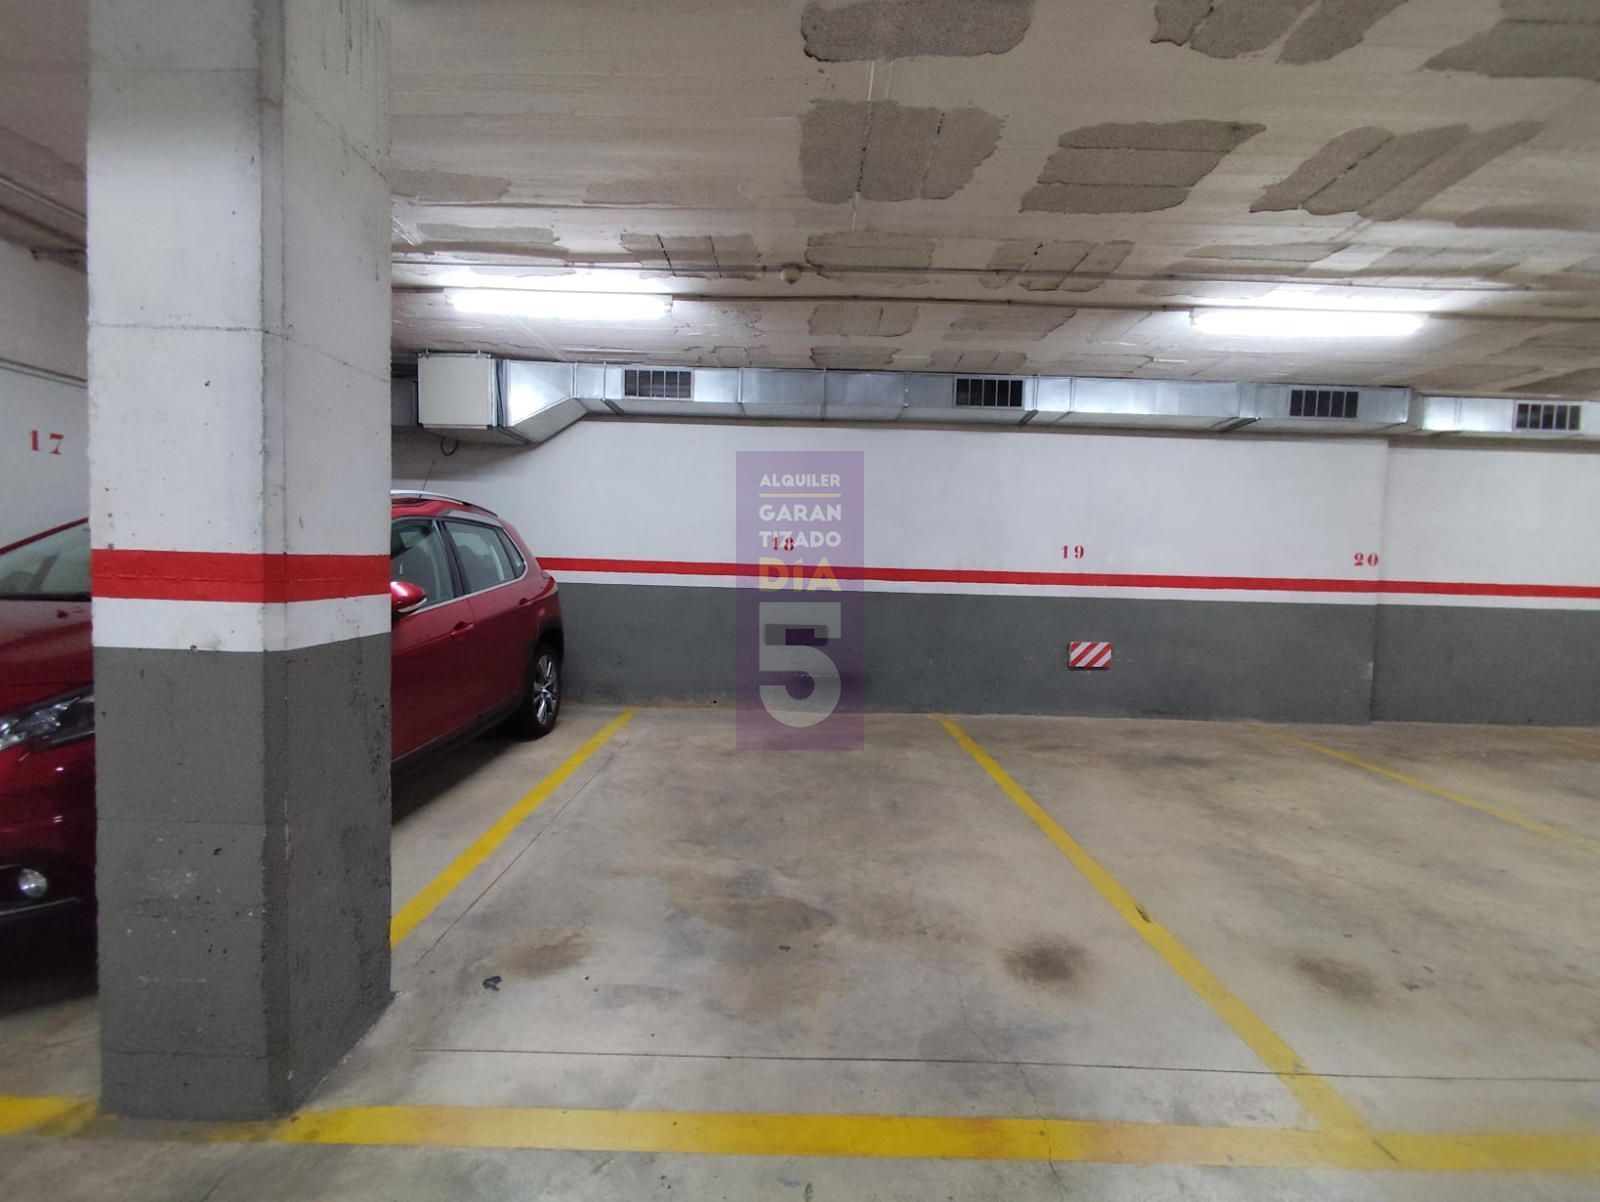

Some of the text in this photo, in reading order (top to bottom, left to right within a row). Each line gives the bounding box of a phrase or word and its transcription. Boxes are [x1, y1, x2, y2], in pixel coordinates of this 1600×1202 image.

[30, 429, 64, 456] 17
[771, 537, 794, 551] 18
[1062, 545, 1085, 560] 19
[1353, 552, 1379, 567] 20
